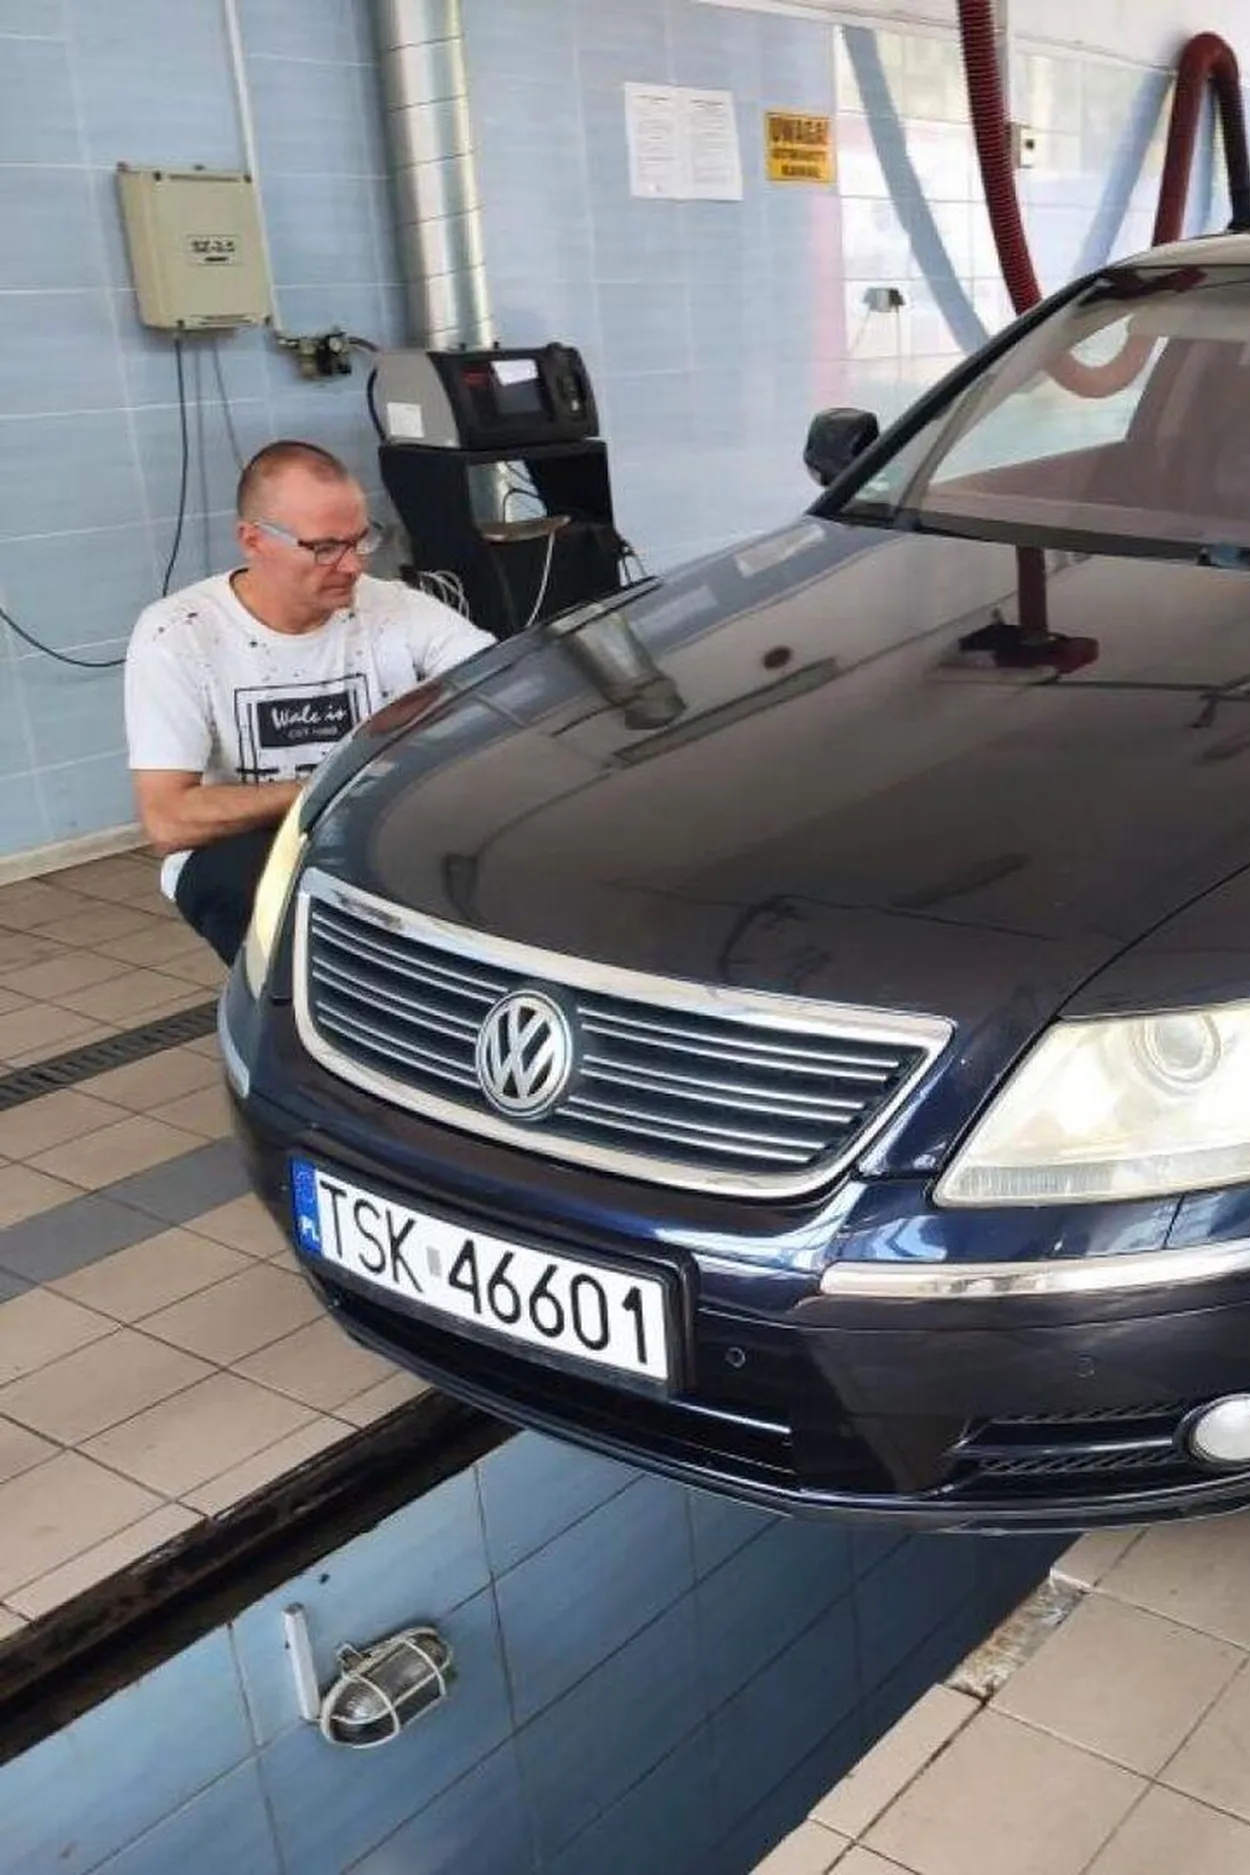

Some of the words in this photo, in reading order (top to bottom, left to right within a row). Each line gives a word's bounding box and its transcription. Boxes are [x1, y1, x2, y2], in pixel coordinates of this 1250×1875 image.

[479, 994, 569, 1115] VW
[319, 1180, 424, 1292] TSK
[448, 1239, 648, 1366] 46601
